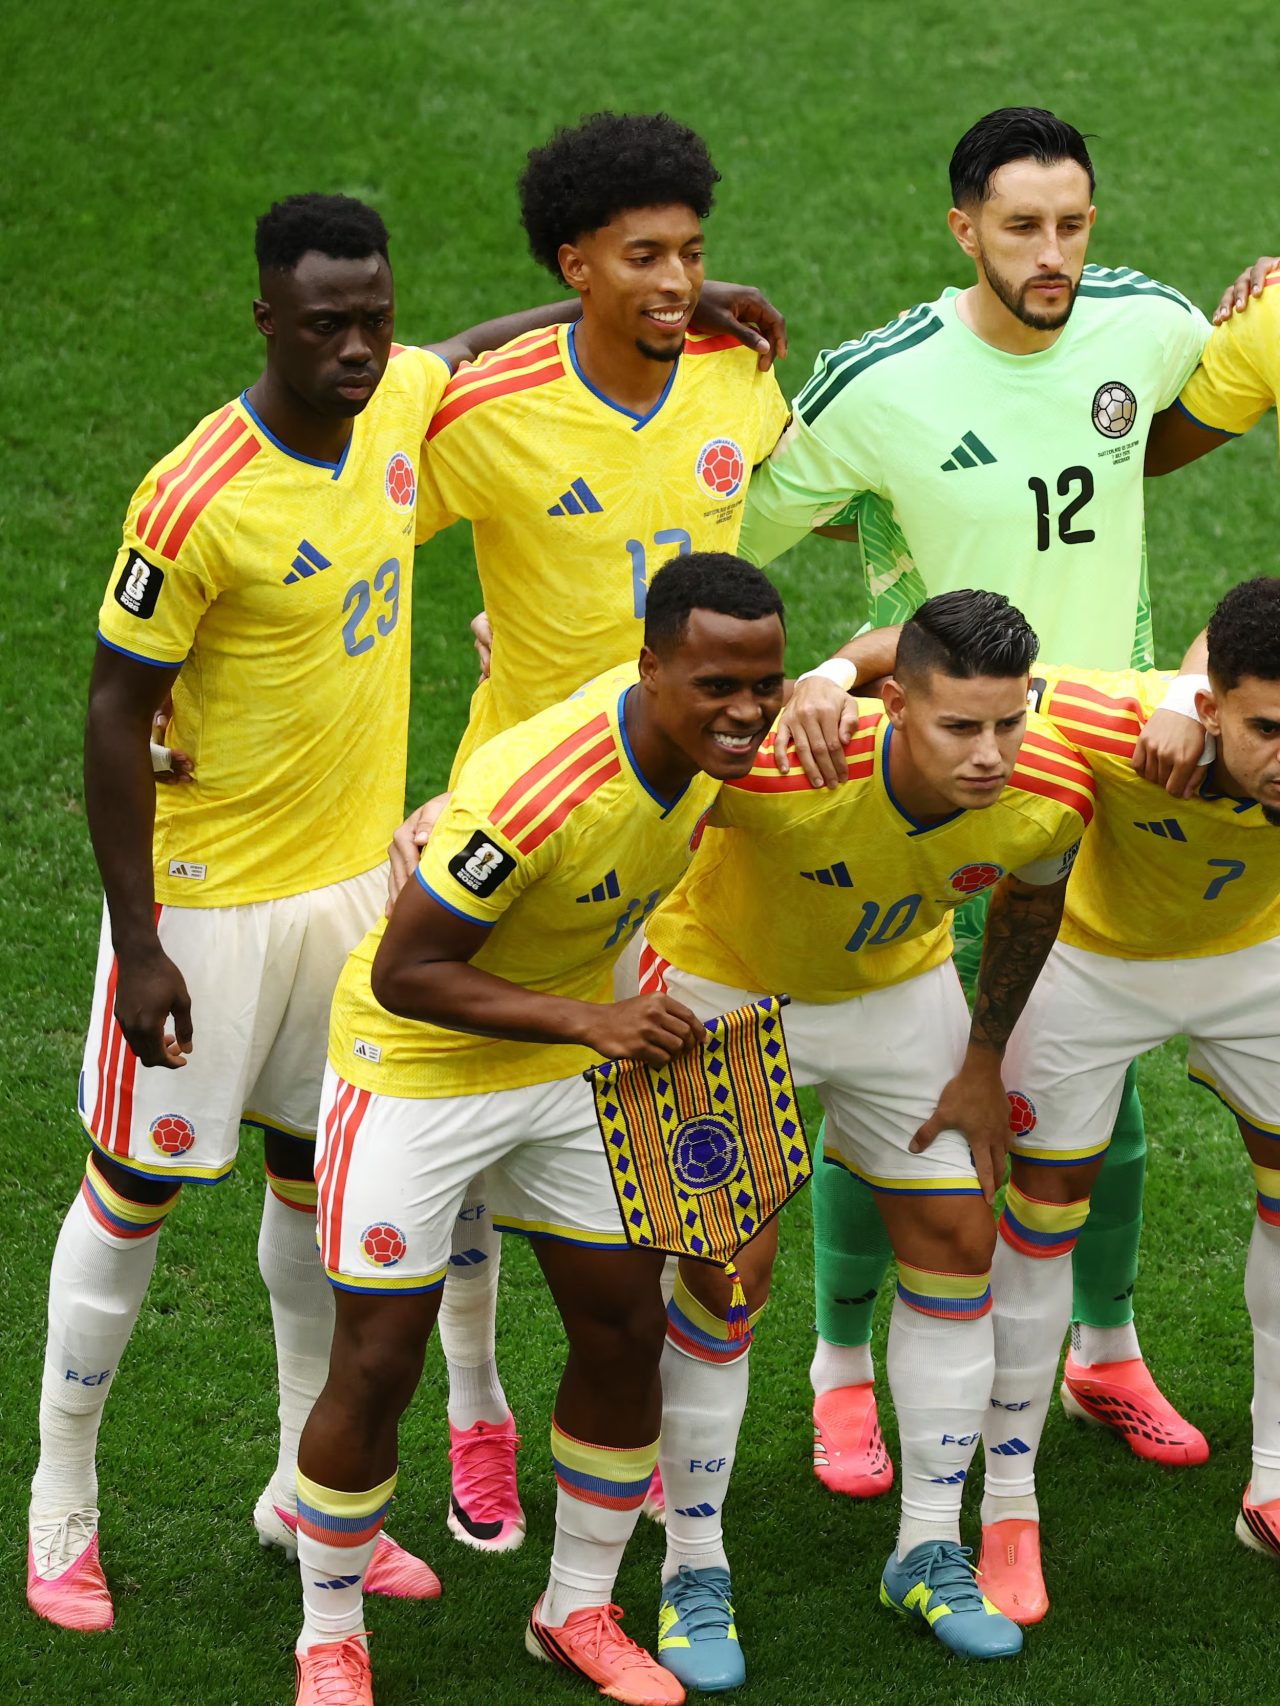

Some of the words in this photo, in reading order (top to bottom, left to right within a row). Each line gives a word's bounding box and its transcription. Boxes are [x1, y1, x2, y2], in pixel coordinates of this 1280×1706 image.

[1028, 466, 1095, 552] 12
[342, 557, 400, 657] 23
[457, 871, 479, 890] 2026
[1203, 859, 1246, 901] 7
[845, 894, 922, 952] 10
[459, 1204, 487, 1220] CF
[66, 1370, 110, 1386] FCF
[991, 1399, 1031, 1411] FCF
[942, 1432, 980, 1446] FCF
[690, 1458, 726, 1473] FCF
